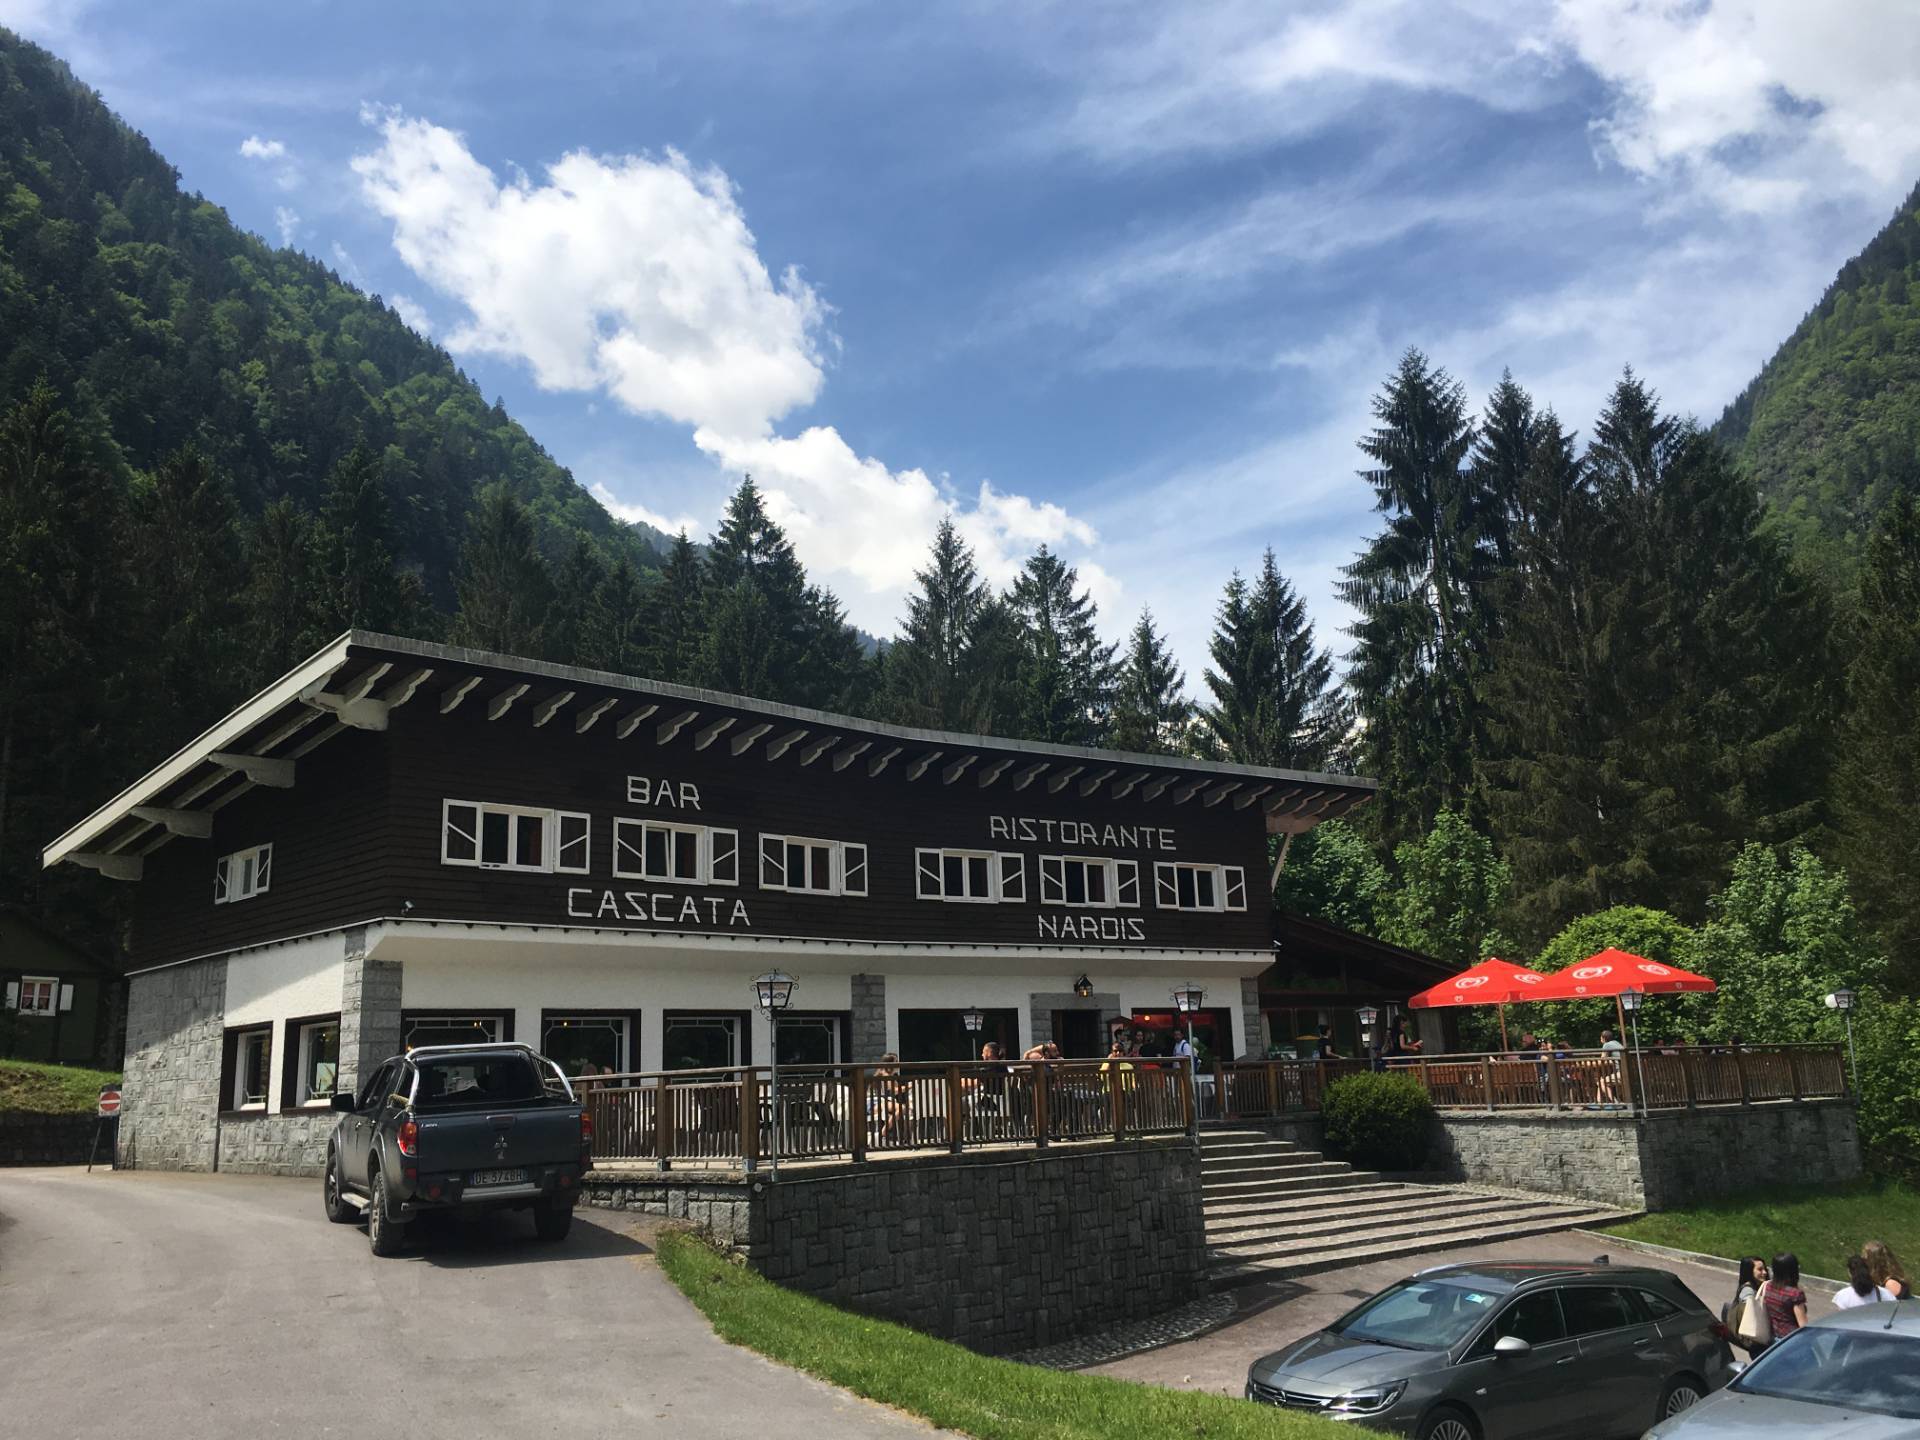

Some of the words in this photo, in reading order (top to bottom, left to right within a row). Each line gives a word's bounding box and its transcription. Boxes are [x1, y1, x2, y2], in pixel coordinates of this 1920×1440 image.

[627, 775, 702, 810] BAR
[989, 815, 1176, 851] RISTORANTE
[567, 887, 751, 927] CASCATA
[1037, 914, 1146, 941] NARDIS
